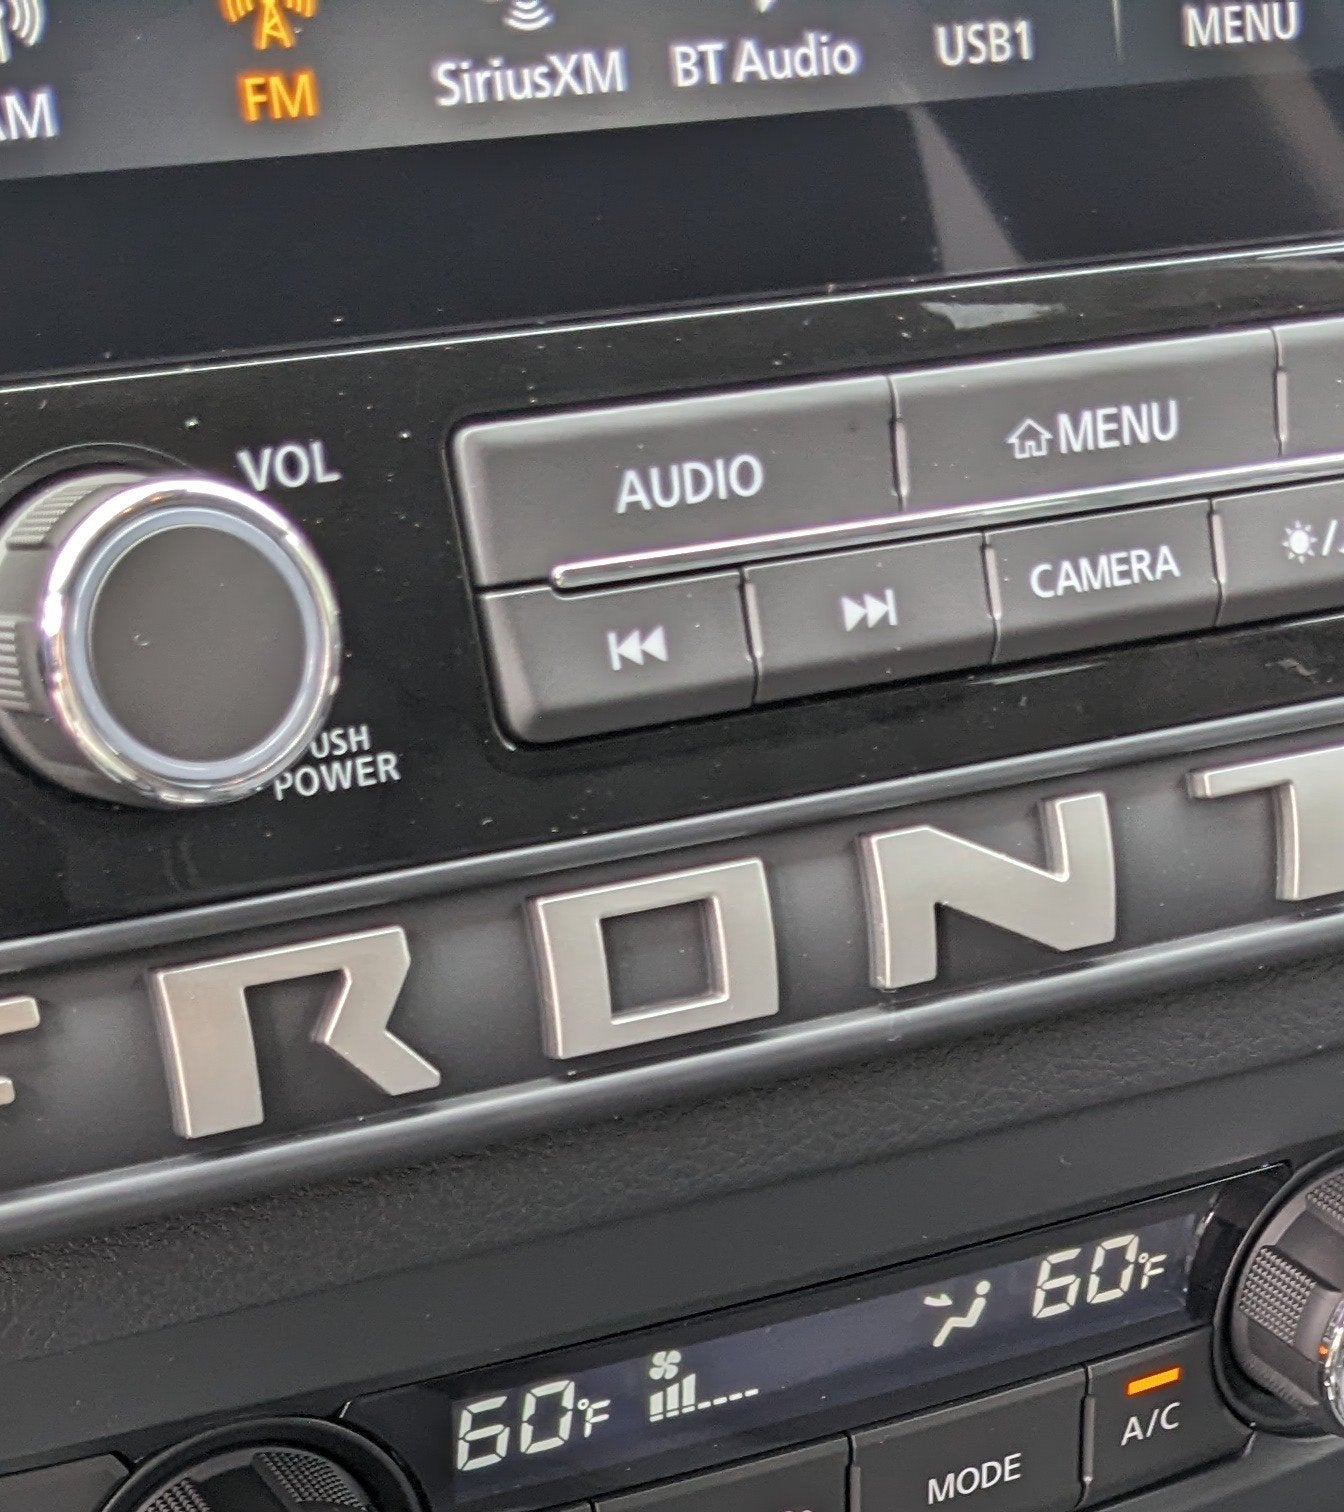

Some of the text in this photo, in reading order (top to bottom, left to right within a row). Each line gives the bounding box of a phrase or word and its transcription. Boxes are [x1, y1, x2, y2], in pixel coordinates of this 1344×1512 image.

[936, 22, 1036, 67] USB1
[1182, 1, 1301, 48] MENU
[434, 48, 630, 109] SiriusXM
[672, 32, 860, 89] BT Audio
[238, 72, 321, 124] FM
[1057, 399, 1180, 456] MENU
[237, 439, 343, 493] VOL
[615, 453, 764, 514] AUDIO
[1029, 544, 1181, 599] CAMERA
[308, 724, 371, 760] USH
[274, 750, 402, 801] POWER
[1120, 1401, 1182, 1446] A/C
[926, 1452, 1022, 1505] MODE
